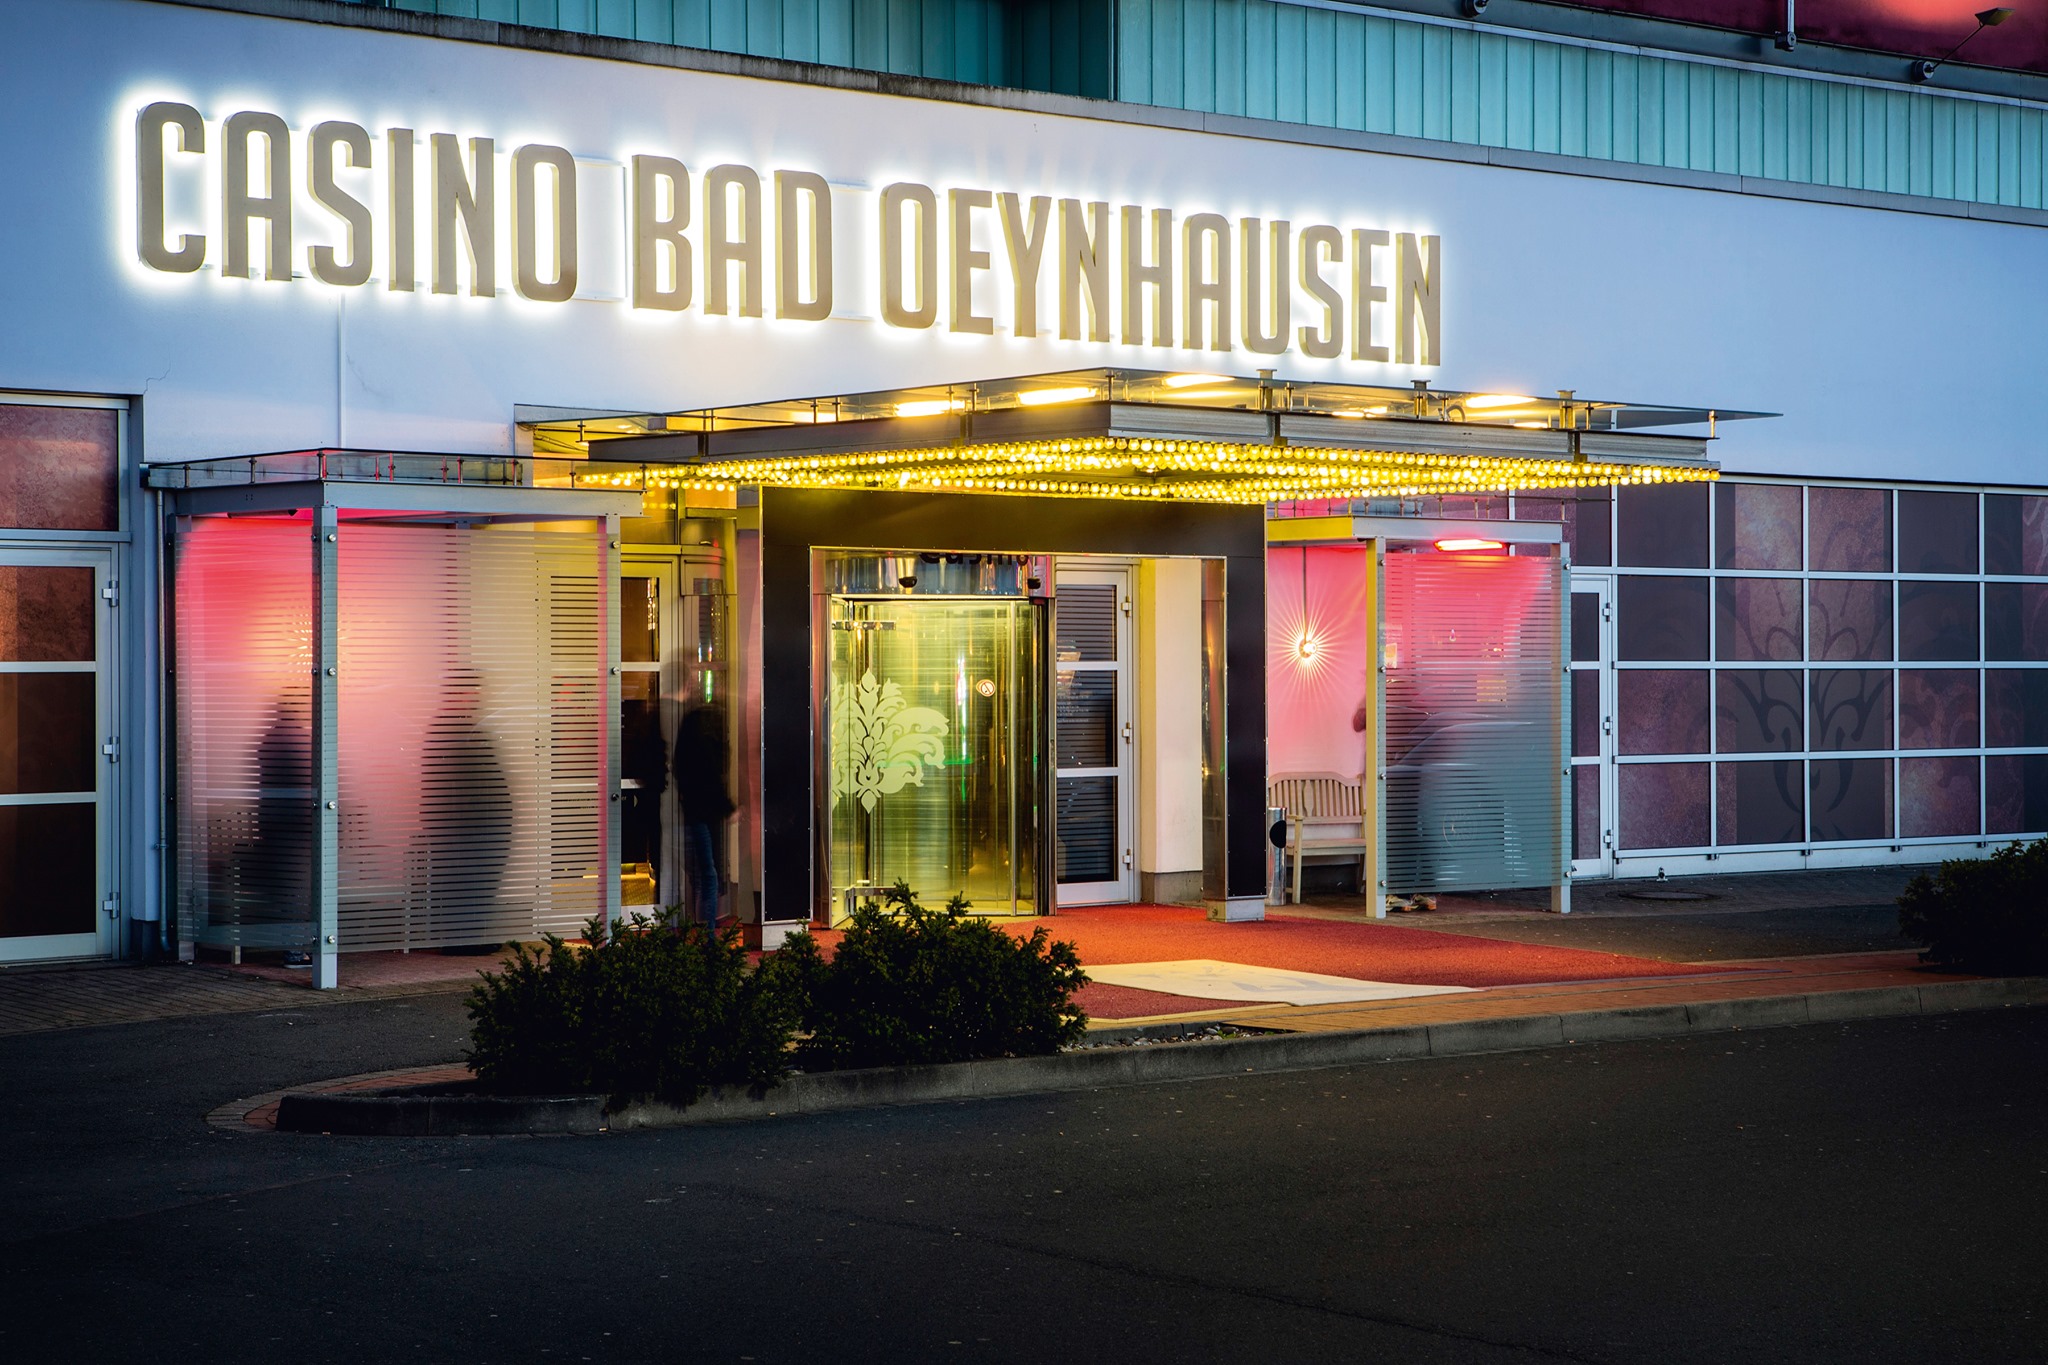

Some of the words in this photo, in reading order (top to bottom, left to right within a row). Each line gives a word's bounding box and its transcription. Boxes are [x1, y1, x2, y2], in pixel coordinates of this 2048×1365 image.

[137, 102, 577, 302] CASINO
[632, 154, 832, 321] BAD
[880, 183, 1441, 366] OEYNHAUSEN
